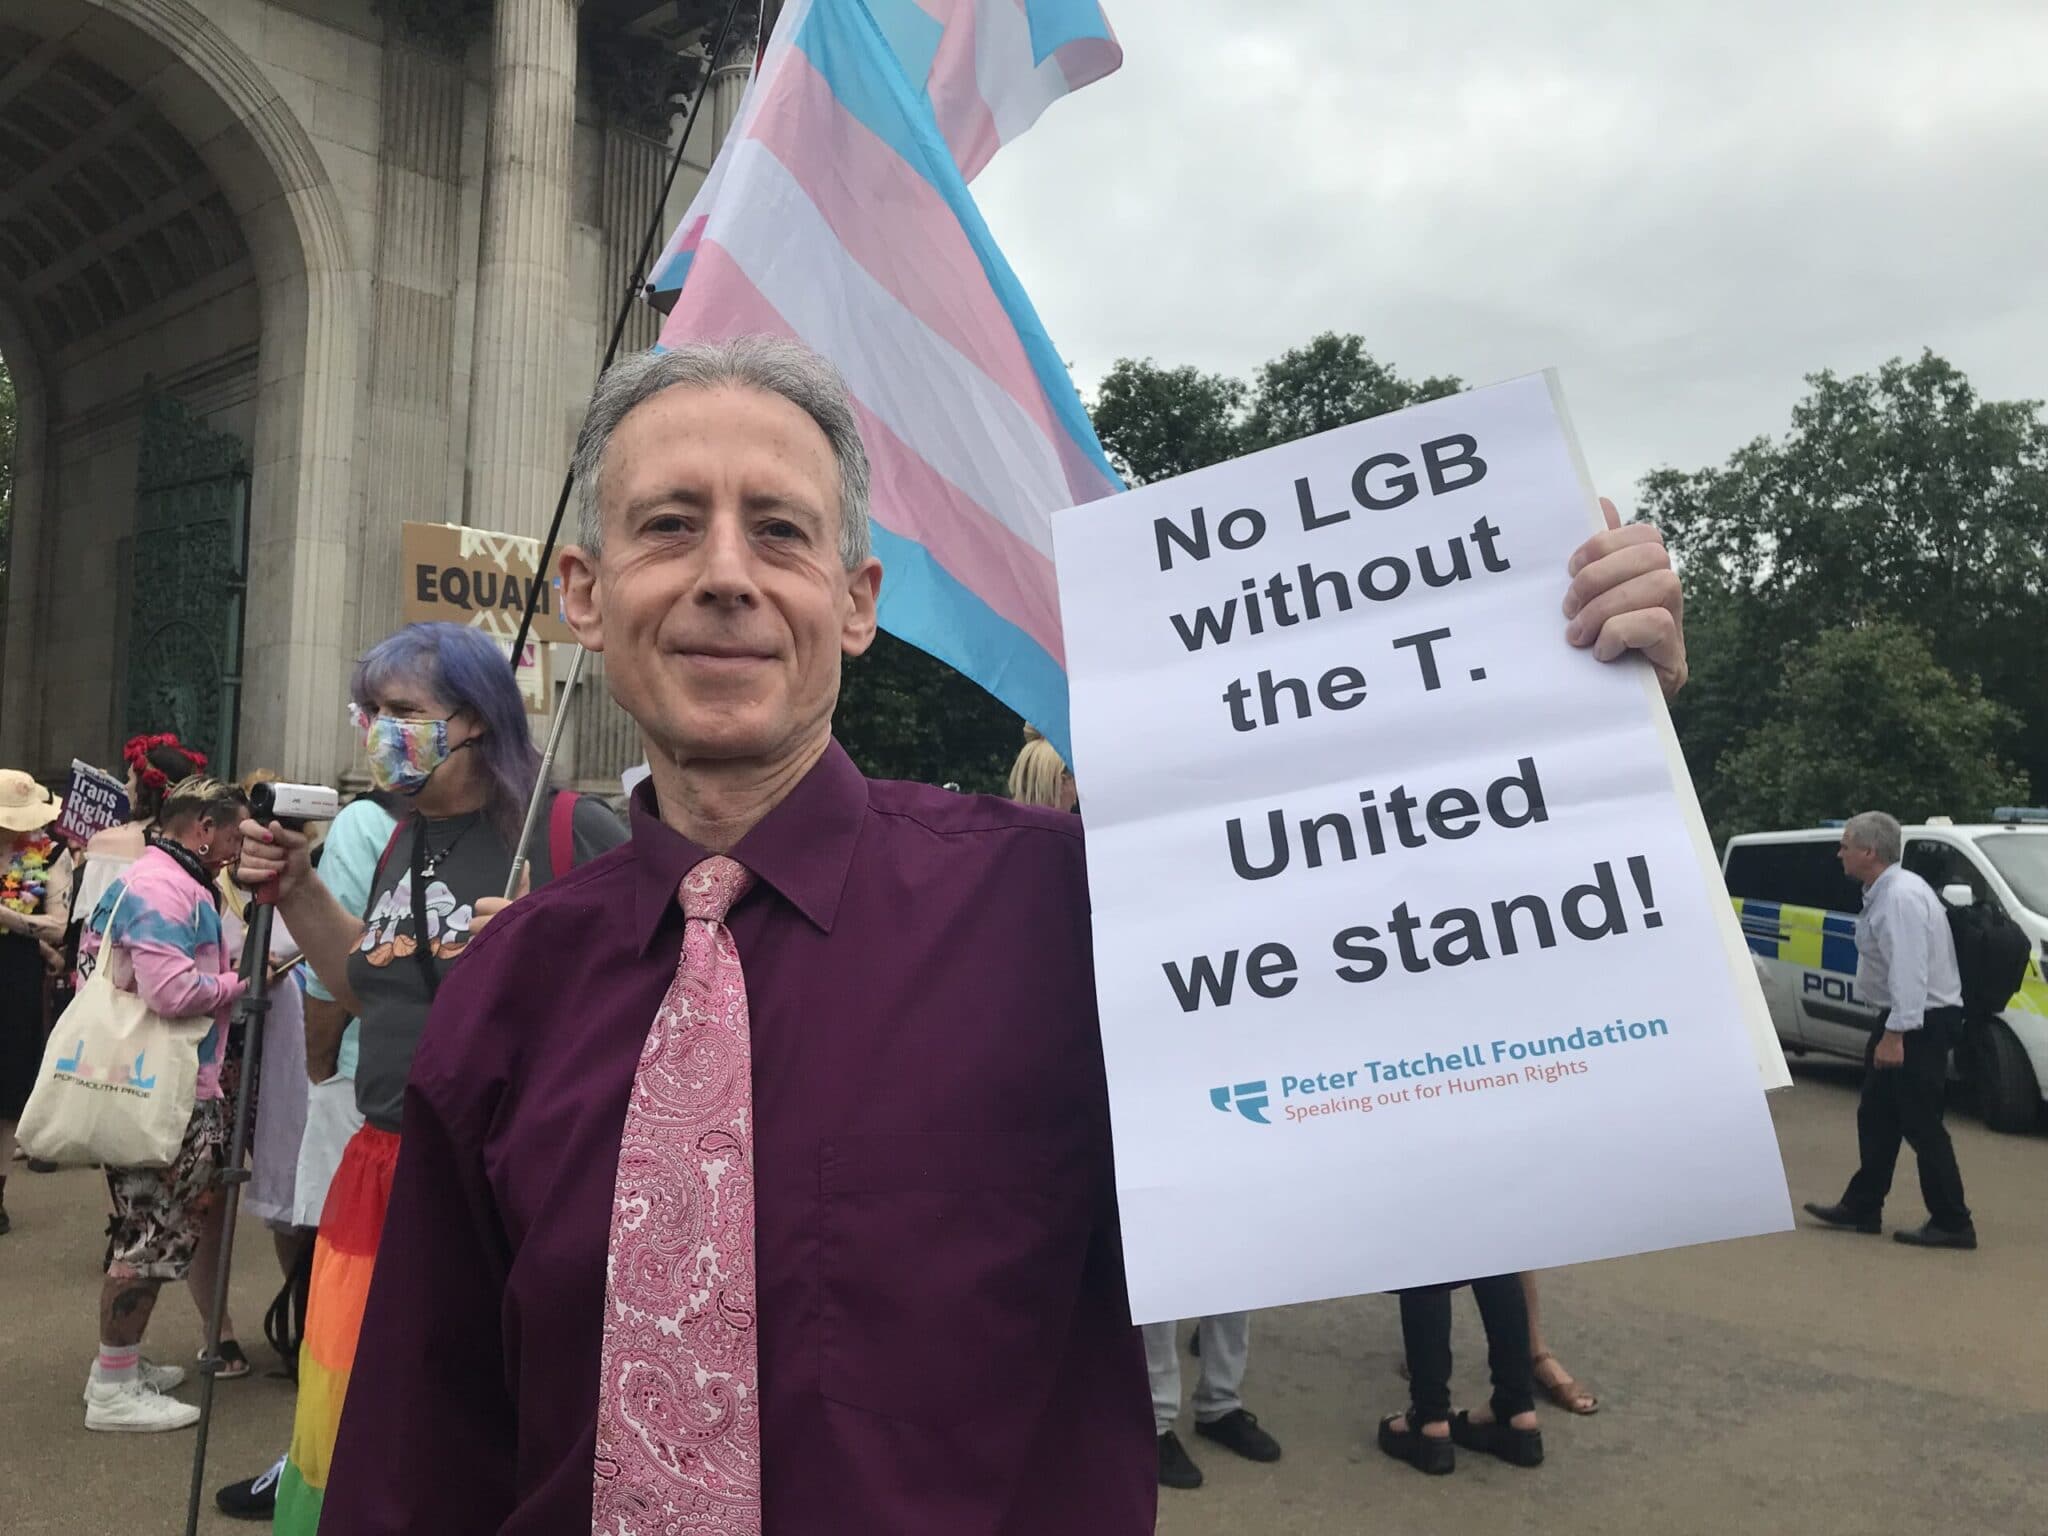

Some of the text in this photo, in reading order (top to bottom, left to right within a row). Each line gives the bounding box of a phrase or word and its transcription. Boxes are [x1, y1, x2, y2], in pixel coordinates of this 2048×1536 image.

[1153, 433, 1488, 572] No LGB
[1169, 515, 1512, 652] without
[1222, 627, 1487, 732] the T.
[73, 770, 118, 809] Trans
[1225, 756, 1549, 881] United
[1161, 854, 1664, 1013] we stand!
[1803, 971, 1869, 1007] POL
[1281, 1015, 1669, 1098] Peter Tatchell Foundation
[1285, 1059, 1589, 1122] Speaking out for Human Rights
